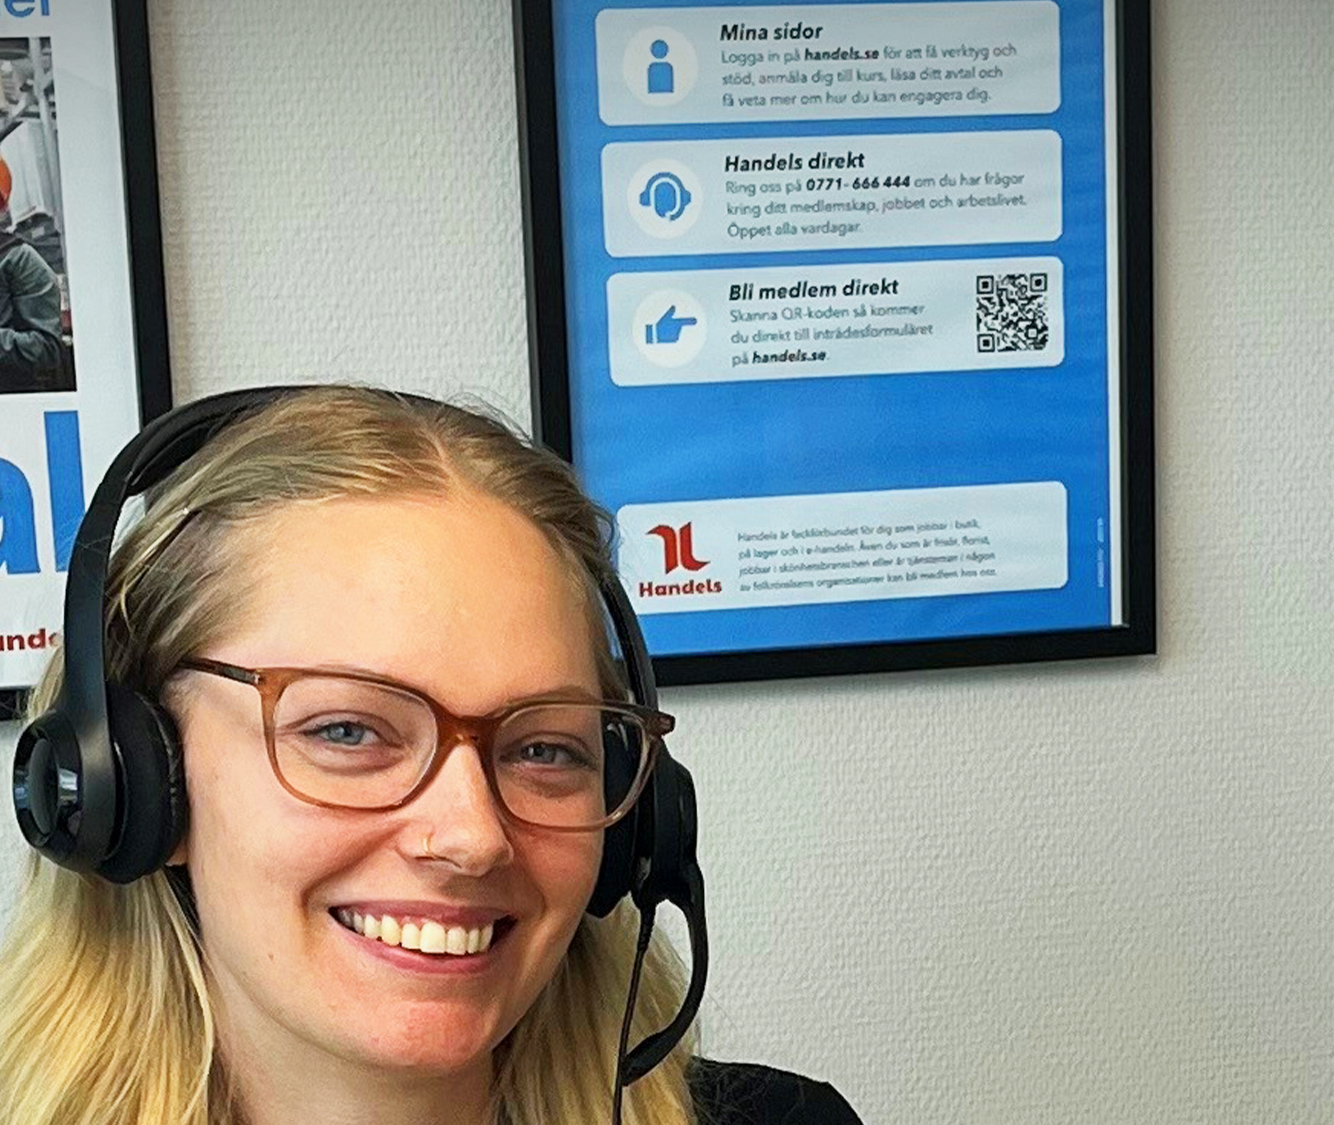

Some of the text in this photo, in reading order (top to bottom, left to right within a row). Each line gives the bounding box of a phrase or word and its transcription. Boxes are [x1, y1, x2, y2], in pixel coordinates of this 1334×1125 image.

[720, 21, 823, 40] Mina sidor
[721, 43, 1016, 66] Logga in på handels.se för att få verktyg och
[722, 65, 1002, 86] stöd, anmäla dig till kurs, läsa ditt avtal och
[722, 86, 992, 106] få veta mer om hur du kan engagera dig.
[725, 151, 864, 172] Handels direkt
[726, 180, 755, 196] Ring
[760, 184, 781, 192] oss
[786, 180, 801, 194] på
[914, 178, 934, 187] om
[939, 174, 955, 186] du
[960, 173, 980, 185] har
[985, 172, 1023, 188] frågor
[727, 201, 761, 218] kring
[764, 200, 787, 214] ditt
[882, 196, 925, 213] jobbet
[929, 195, 952, 208] och
[727, 221, 771, 240] Öppet
[774, 221, 797, 235] alla
[729, 277, 898, 300] Bli medlem direkt
[730, 303, 924, 322] Skanna QR-koden så kommer
[730, 321, 933, 344] du direkt till inträdesformuläret
[732, 354, 748, 366] på
[639, 578, 721, 597] Handels
